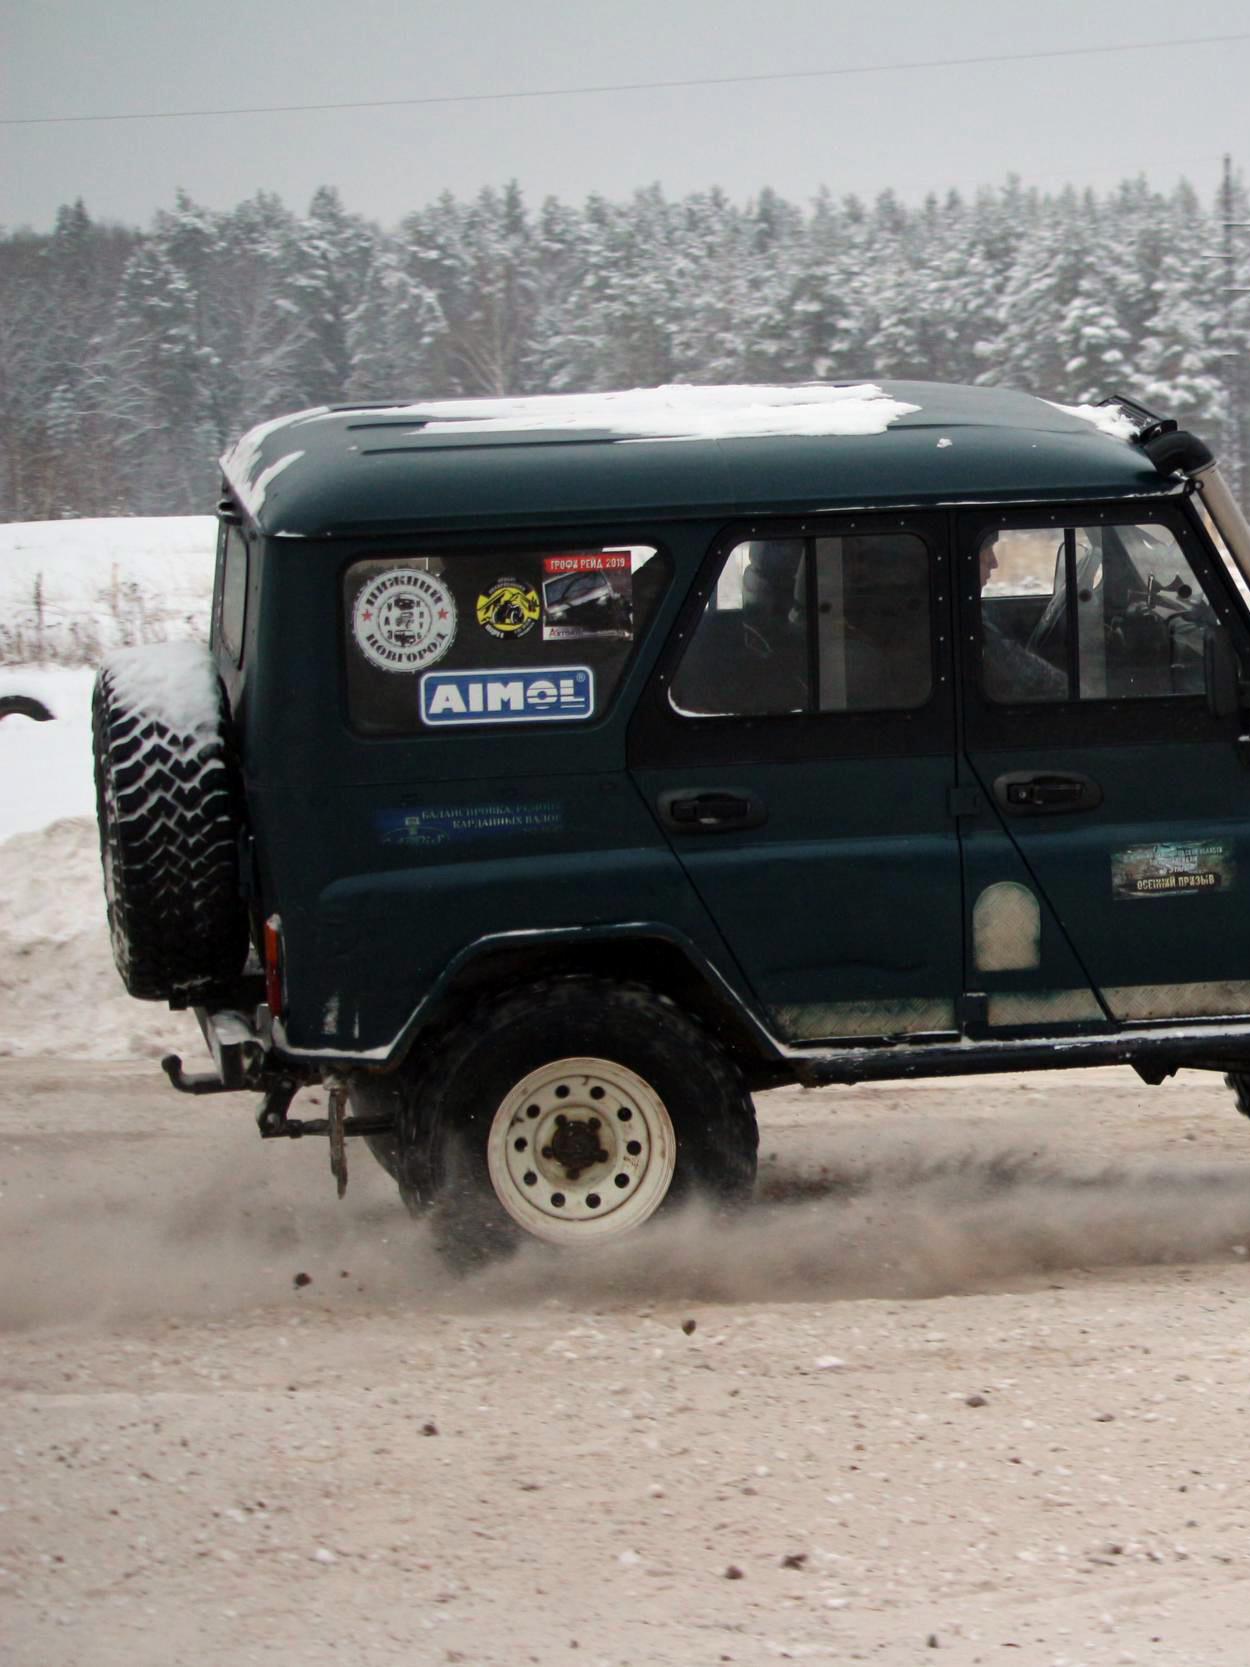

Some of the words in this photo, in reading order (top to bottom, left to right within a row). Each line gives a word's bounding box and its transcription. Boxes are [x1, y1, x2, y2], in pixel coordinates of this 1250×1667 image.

[606, 557, 626, 568] 2019
[365, 575, 444, 607] НИЖНИЙ
[365, 631, 449, 663] НОВГОРОД
